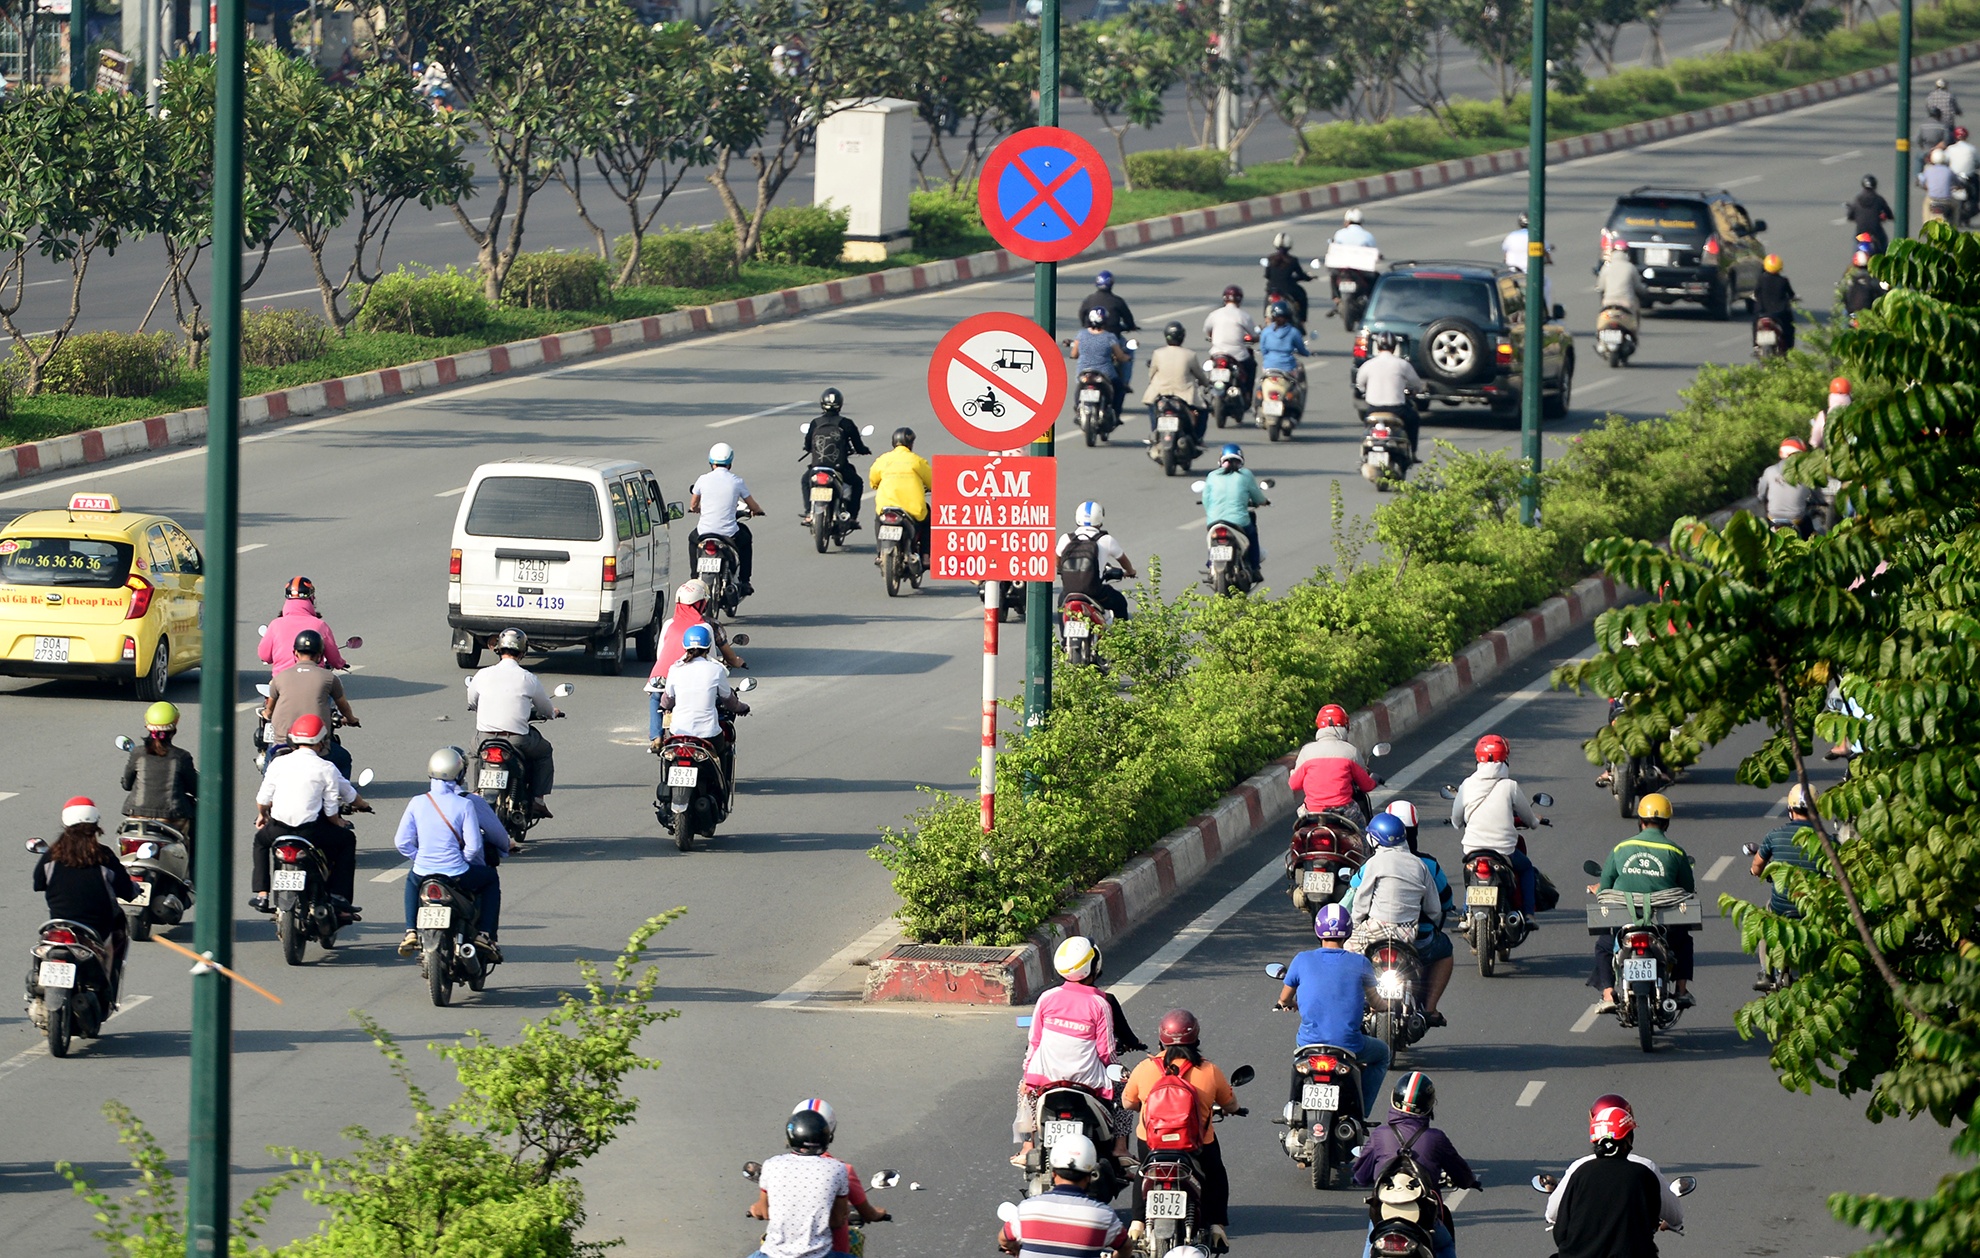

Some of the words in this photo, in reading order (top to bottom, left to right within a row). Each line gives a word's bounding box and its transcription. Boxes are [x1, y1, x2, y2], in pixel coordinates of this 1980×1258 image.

[956, 457, 1032, 498] CẤM
[77, 498, 106, 509] TAXI
[939, 505, 957, 525] XE
[961, 505, 971, 525] 2
[975, 500, 993, 525] VÀ
[997, 505, 1007, 525] 3
[1011, 500, 1049, 526] BÁNH
[35, 555, 50, 568] 36
[52, 555, 67, 568] 36
[69, 556, 84, 569] 36
[86, 557, 101, 570] 36
[517, 571, 545, 582] 4139
[67, 596, 98, 608] Cheap
[101, 597, 123, 606] Taxi
[496, 594, 524, 608] 52LD
[536, 596, 565, 610] 4139
[42, 638, 61, 649] 60A
[34, 649, 68, 661] 273.90
[1638, 858, 1650, 868] 36
[1308, 873, 1330, 883] 59-S2
[1304, 882, 1332, 893] 204.92
[1628, 960, 1653, 970] 72-K5
[1628, 970, 1653, 980] 2860
[1309, 1086, 1333, 1098] 79-Z1
[1304, 1097, 1337, 1109] 206.94
[1051, 1122, 1076, 1135] 59-C1
[1153, 1192, 1181, 1204] 60-T2
[1152, 1204, 1180, 1216] 9842
